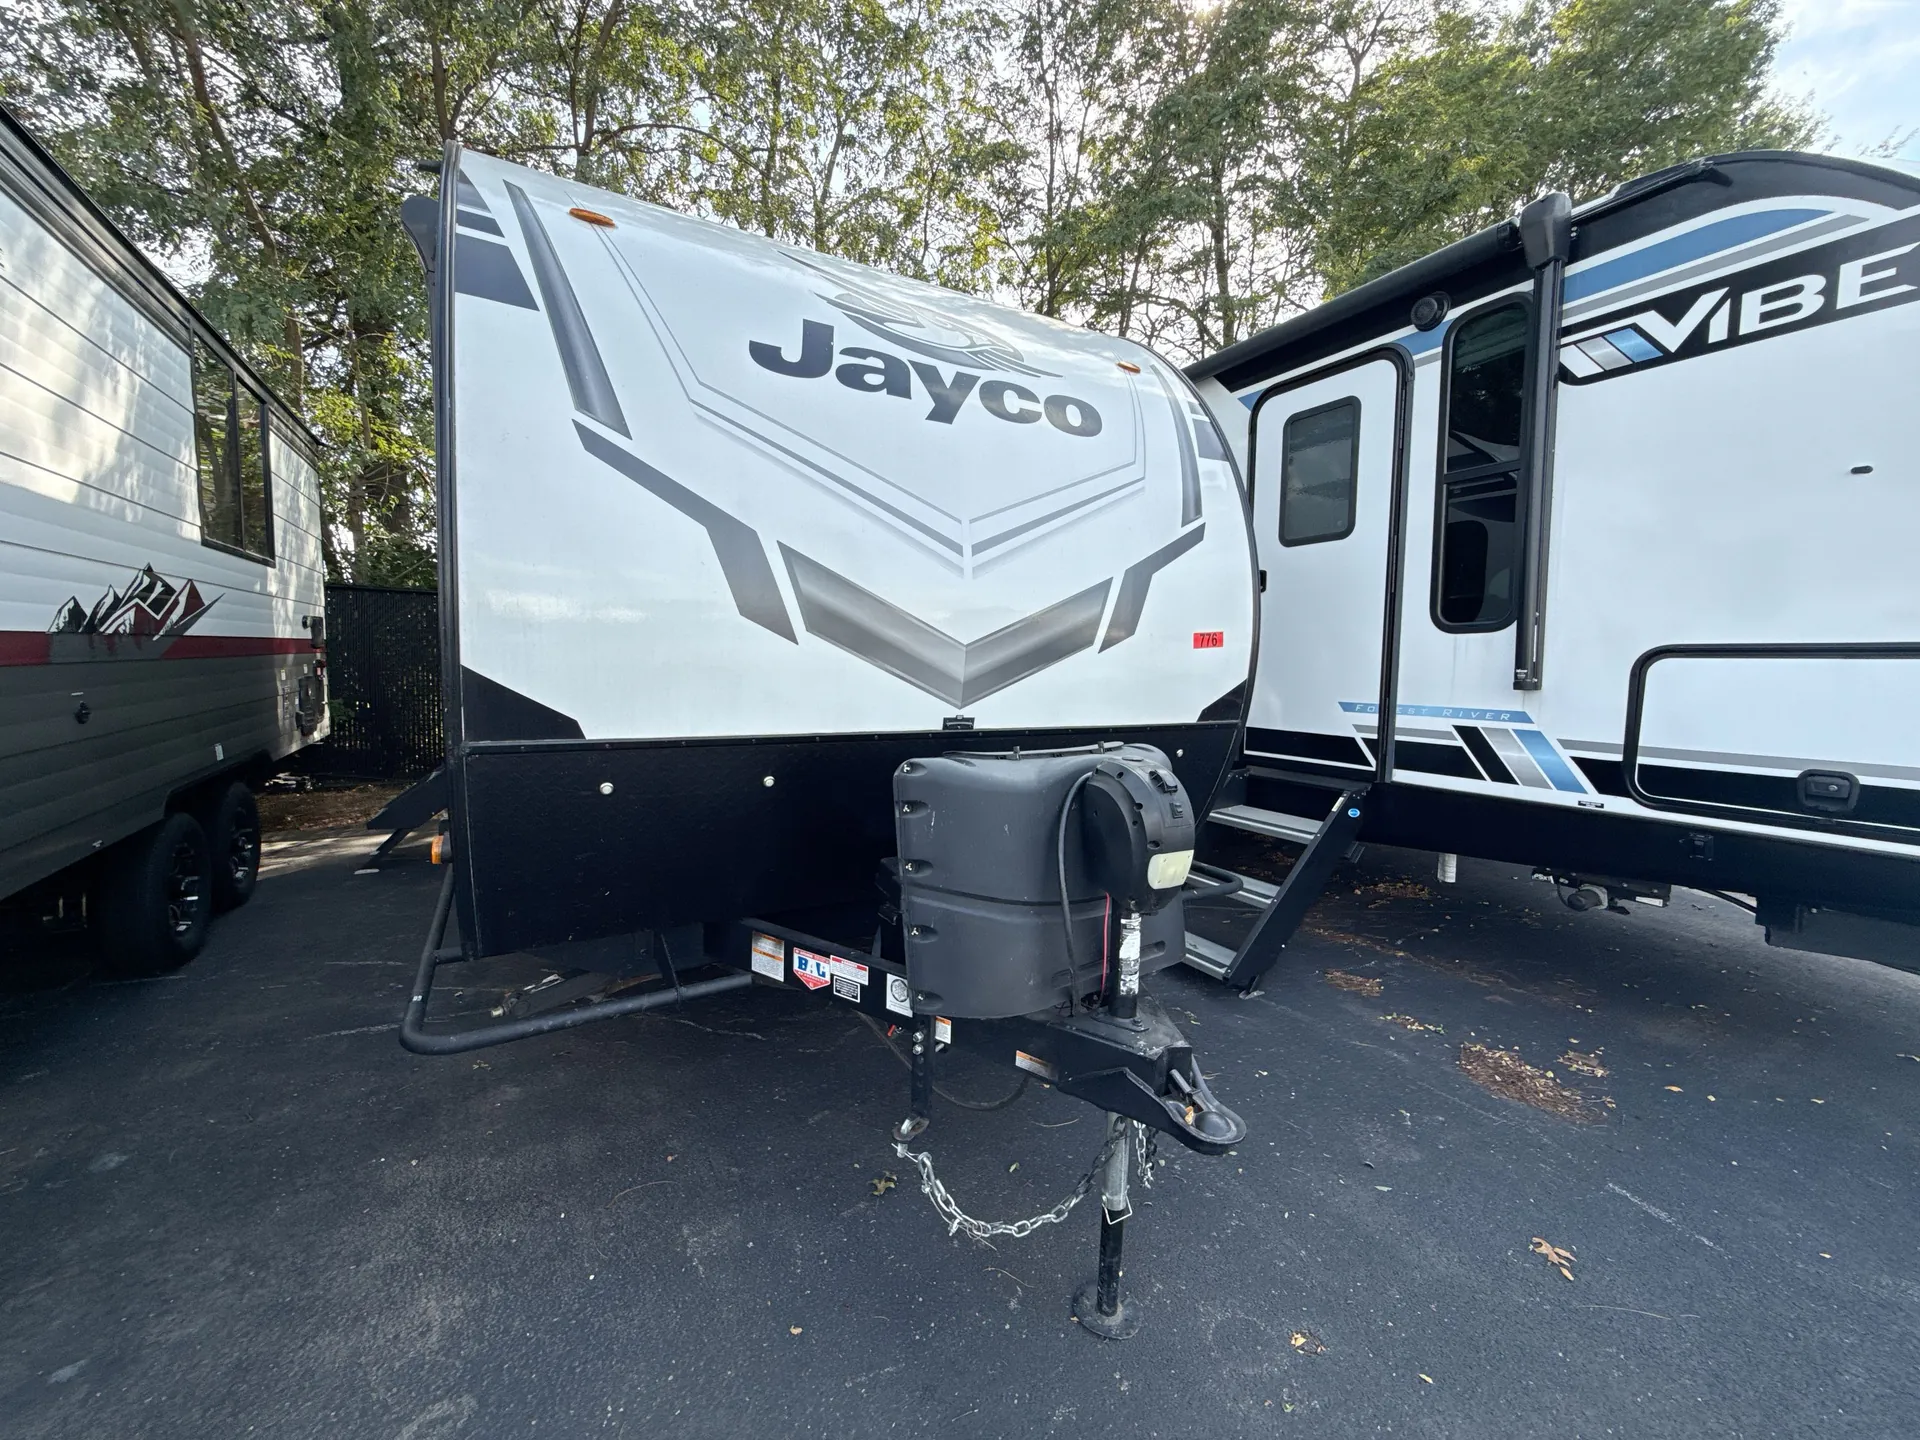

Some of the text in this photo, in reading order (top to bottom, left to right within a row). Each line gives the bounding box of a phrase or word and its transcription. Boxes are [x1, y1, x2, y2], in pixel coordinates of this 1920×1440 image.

[1634, 241, 1920, 352] VIBE
[749, 318, 1103, 438] Jayco
[1199, 632, 1217, 648] 776
[1355, 704, 1511, 721] FOEST RIVER
